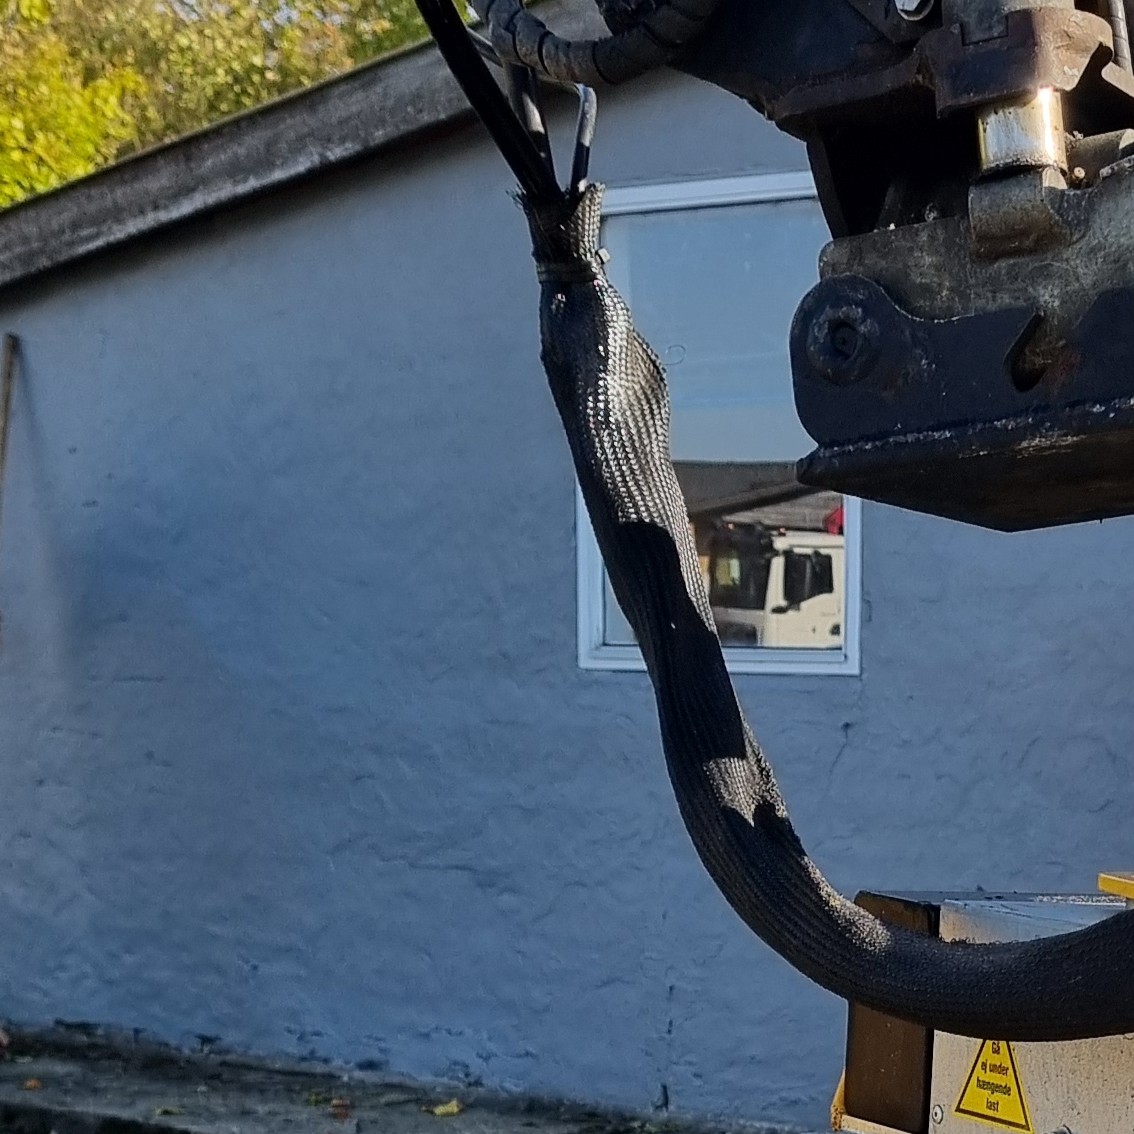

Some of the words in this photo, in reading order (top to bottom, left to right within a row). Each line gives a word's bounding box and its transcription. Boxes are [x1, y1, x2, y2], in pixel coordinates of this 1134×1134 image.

[980, 1058, 988, 1074] ej
[988, 1062, 1009, 1076] under
[976, 1076, 1012, 1096] hængende
[985, 1097, 999, 1112] last
